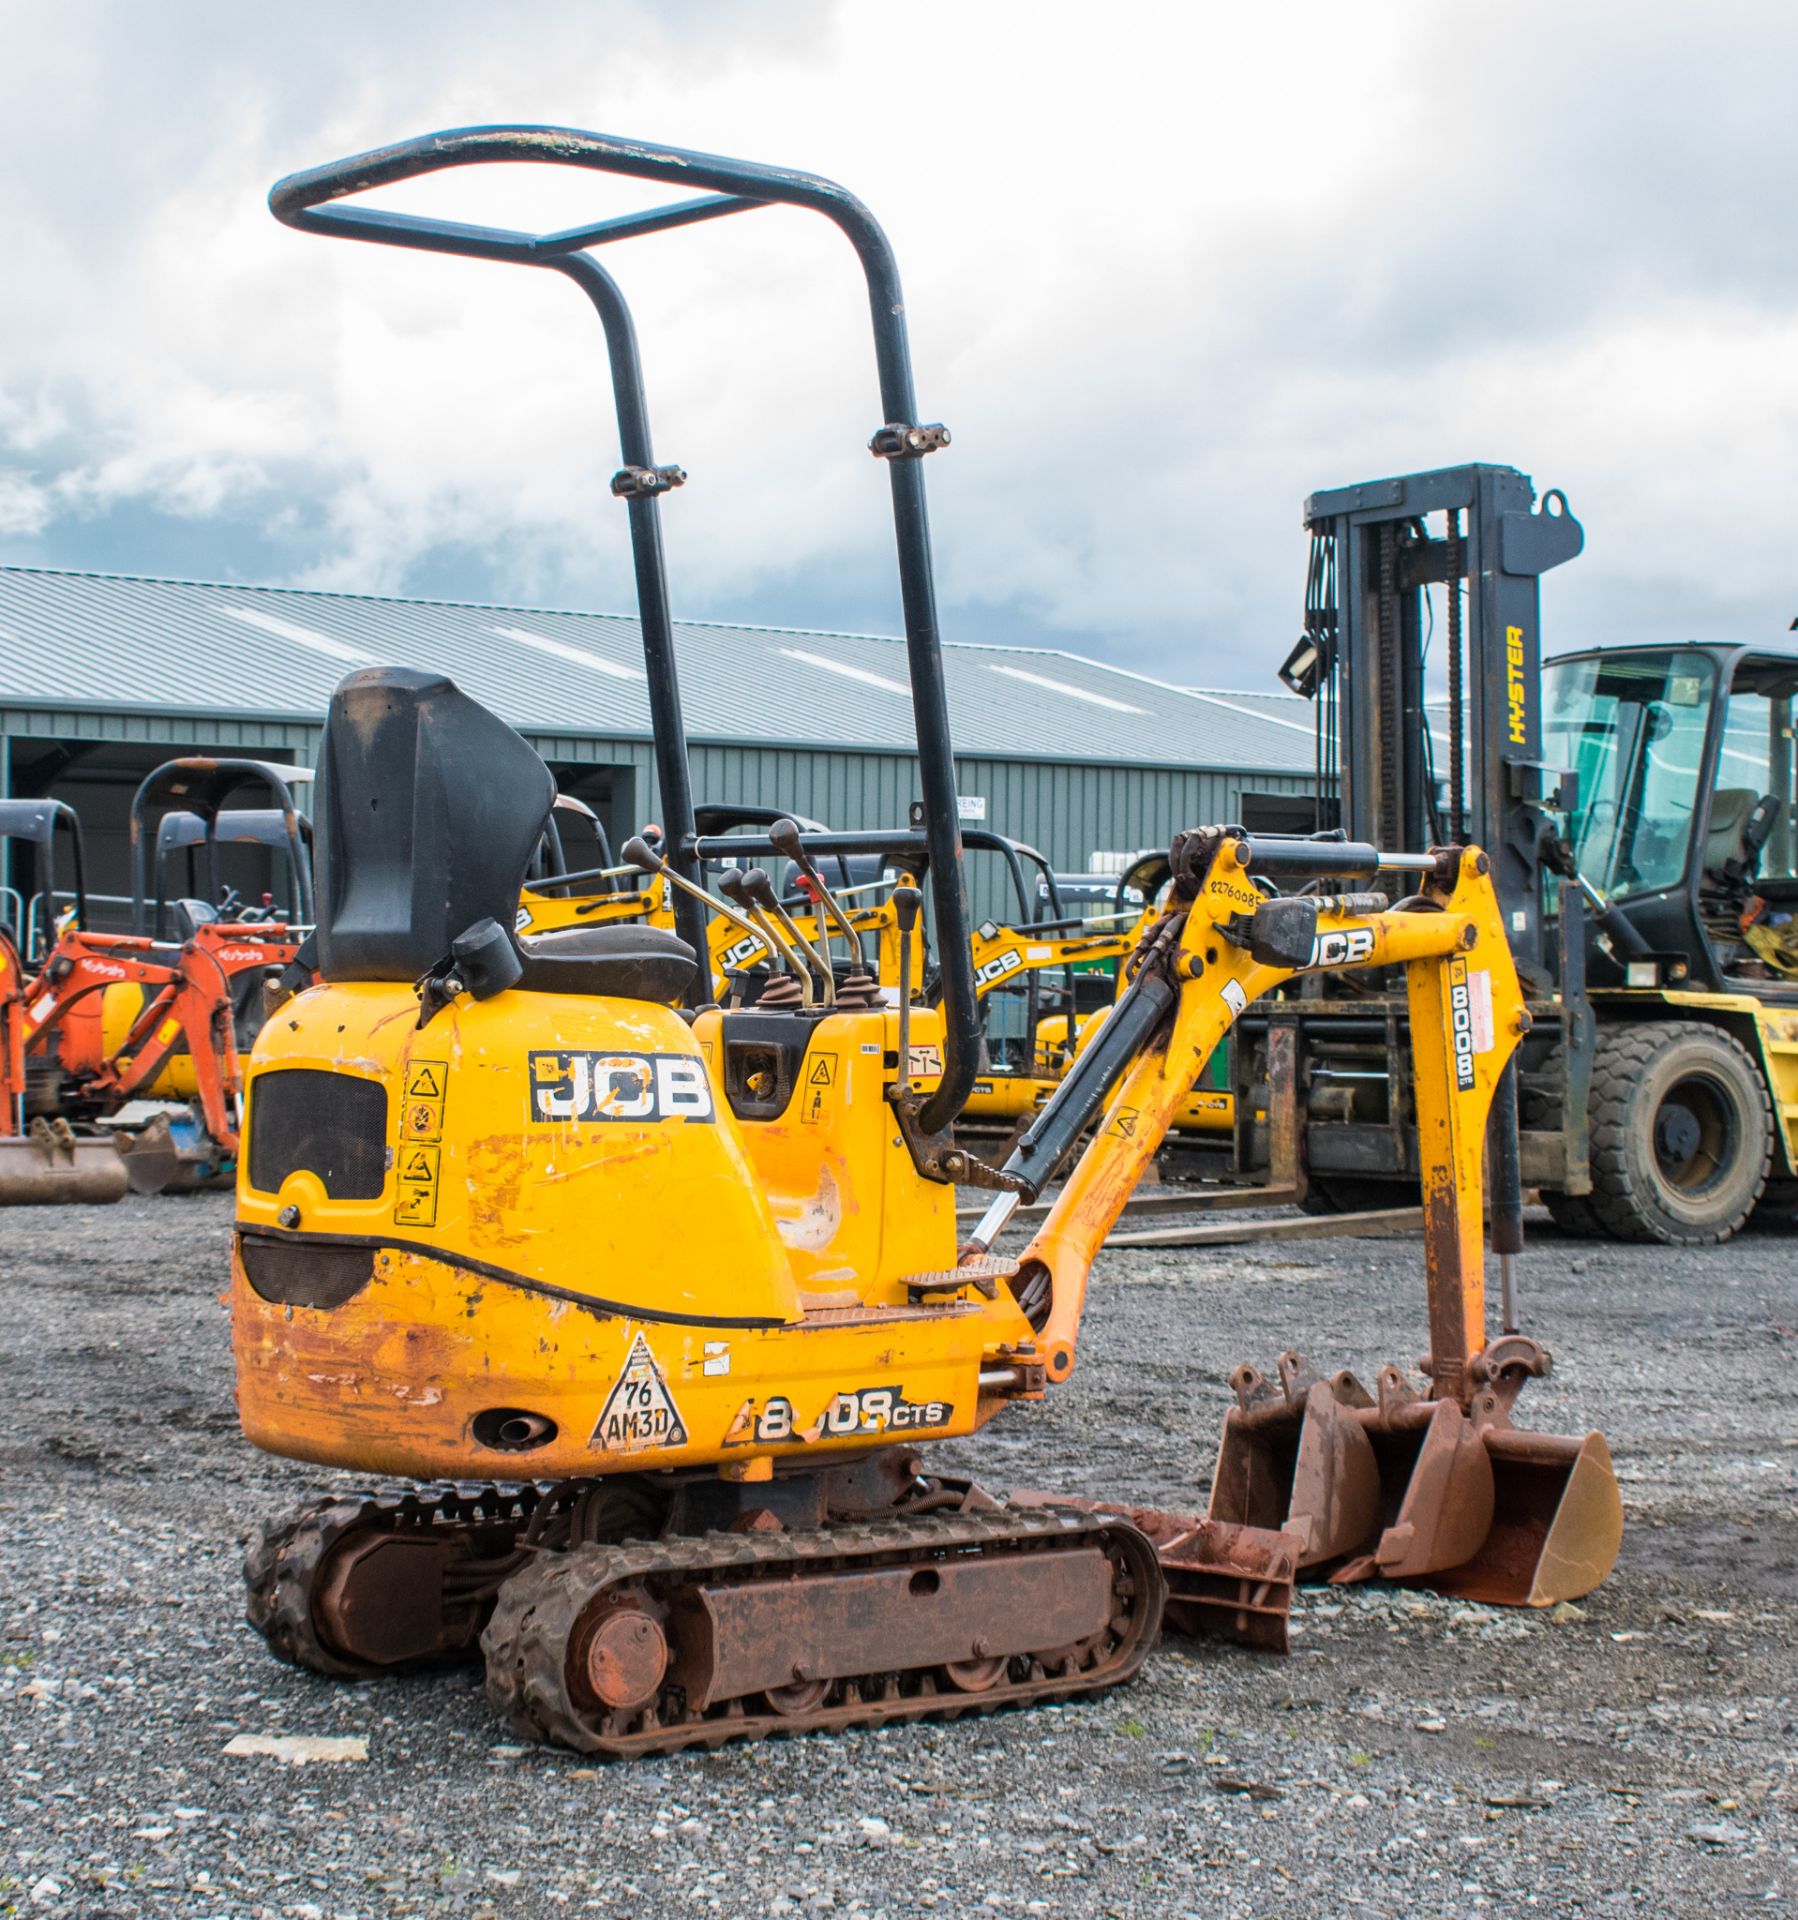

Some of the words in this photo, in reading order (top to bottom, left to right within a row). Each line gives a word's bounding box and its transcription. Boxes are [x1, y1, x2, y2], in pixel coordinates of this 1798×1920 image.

[1506, 625, 1526, 745] HYSTER
[1451, 985, 1474, 1077] 8008
[536, 1055, 713, 1117] JCB
[624, 1380, 652, 1409] 76
[757, 1390, 893, 1441] 808
[893, 1401, 944, 1427] CTS
[606, 1407, 669, 1442] AM3D
